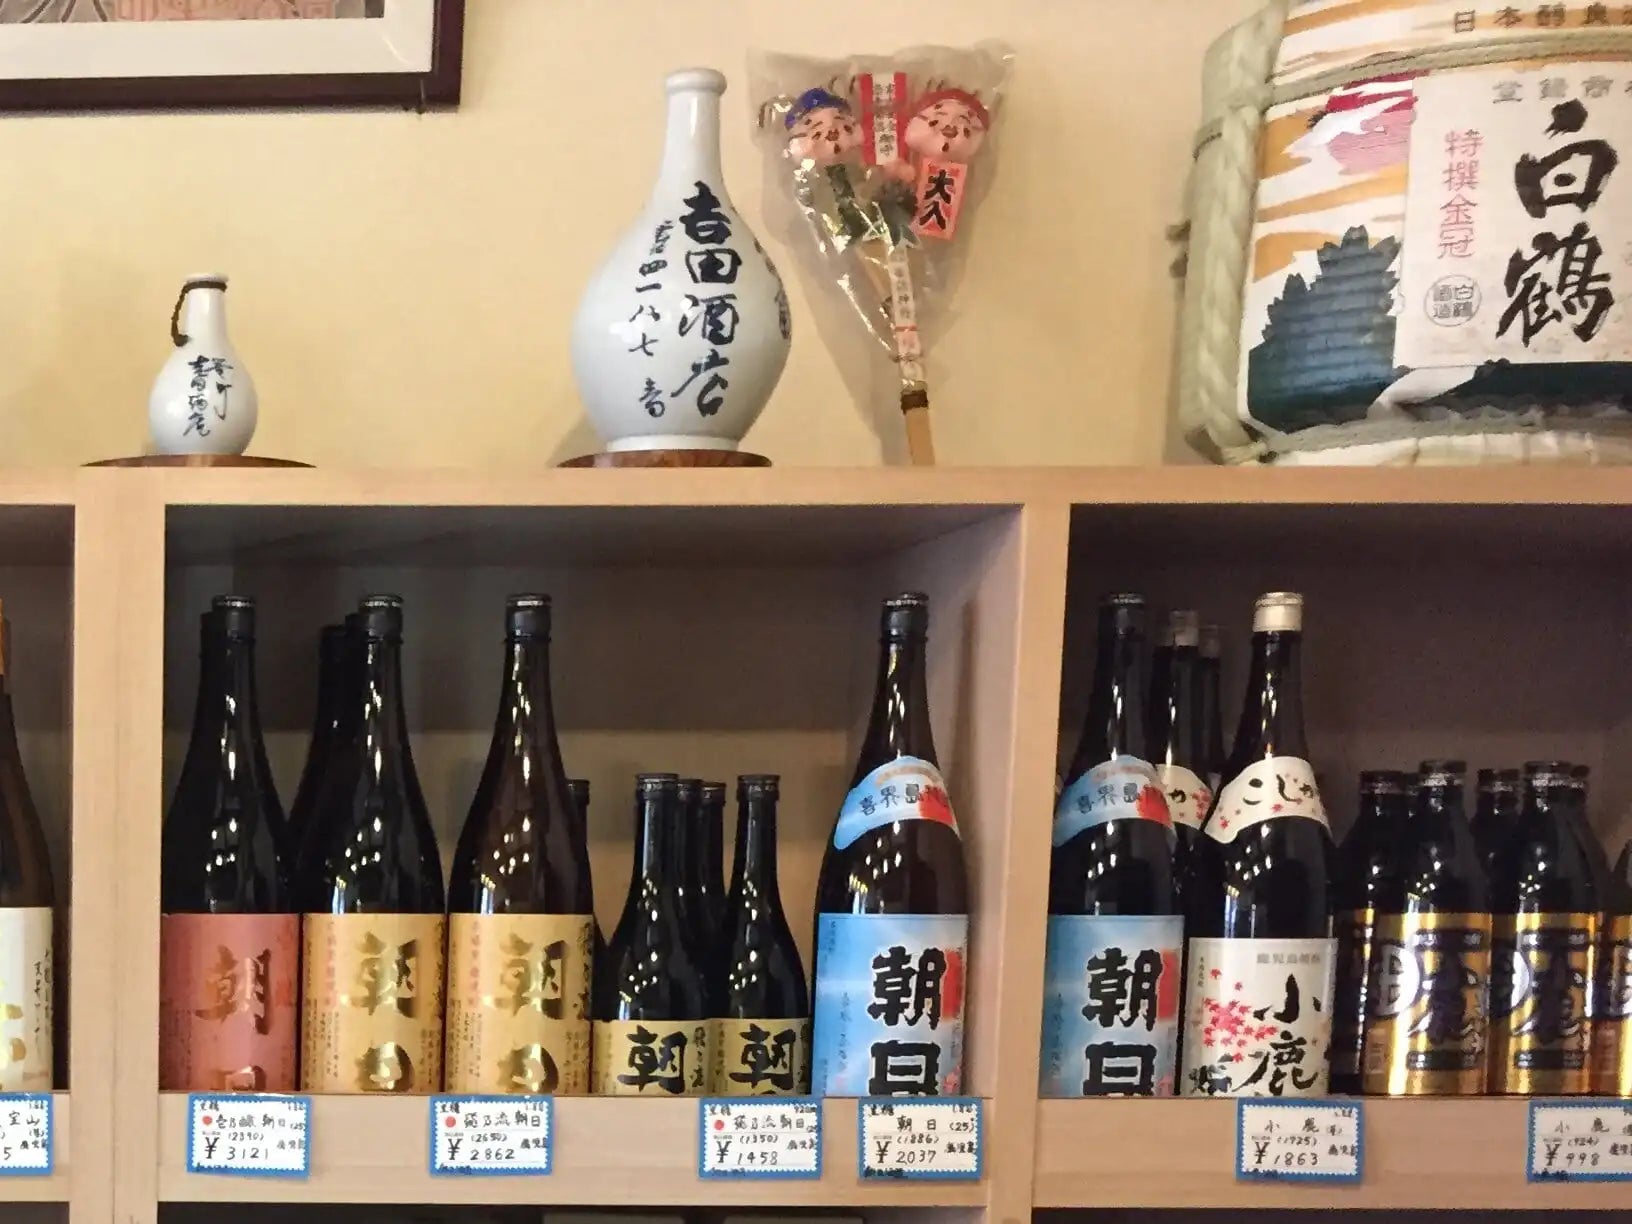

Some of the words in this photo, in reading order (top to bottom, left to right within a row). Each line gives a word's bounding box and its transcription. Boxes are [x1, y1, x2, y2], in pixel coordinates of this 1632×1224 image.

[919, 168, 954, 230] 大入
[1437, 129, 1484, 260] 特撰金冠
[1496, 98, 1618, 348] 白鶴
[868, 946, 945, 1098] 朝日
[1082, 945, 1163, 1098] 朝日
[1232, 974, 1322, 1096] 小鹿
[898, 1118, 937, 1131] 朝日
